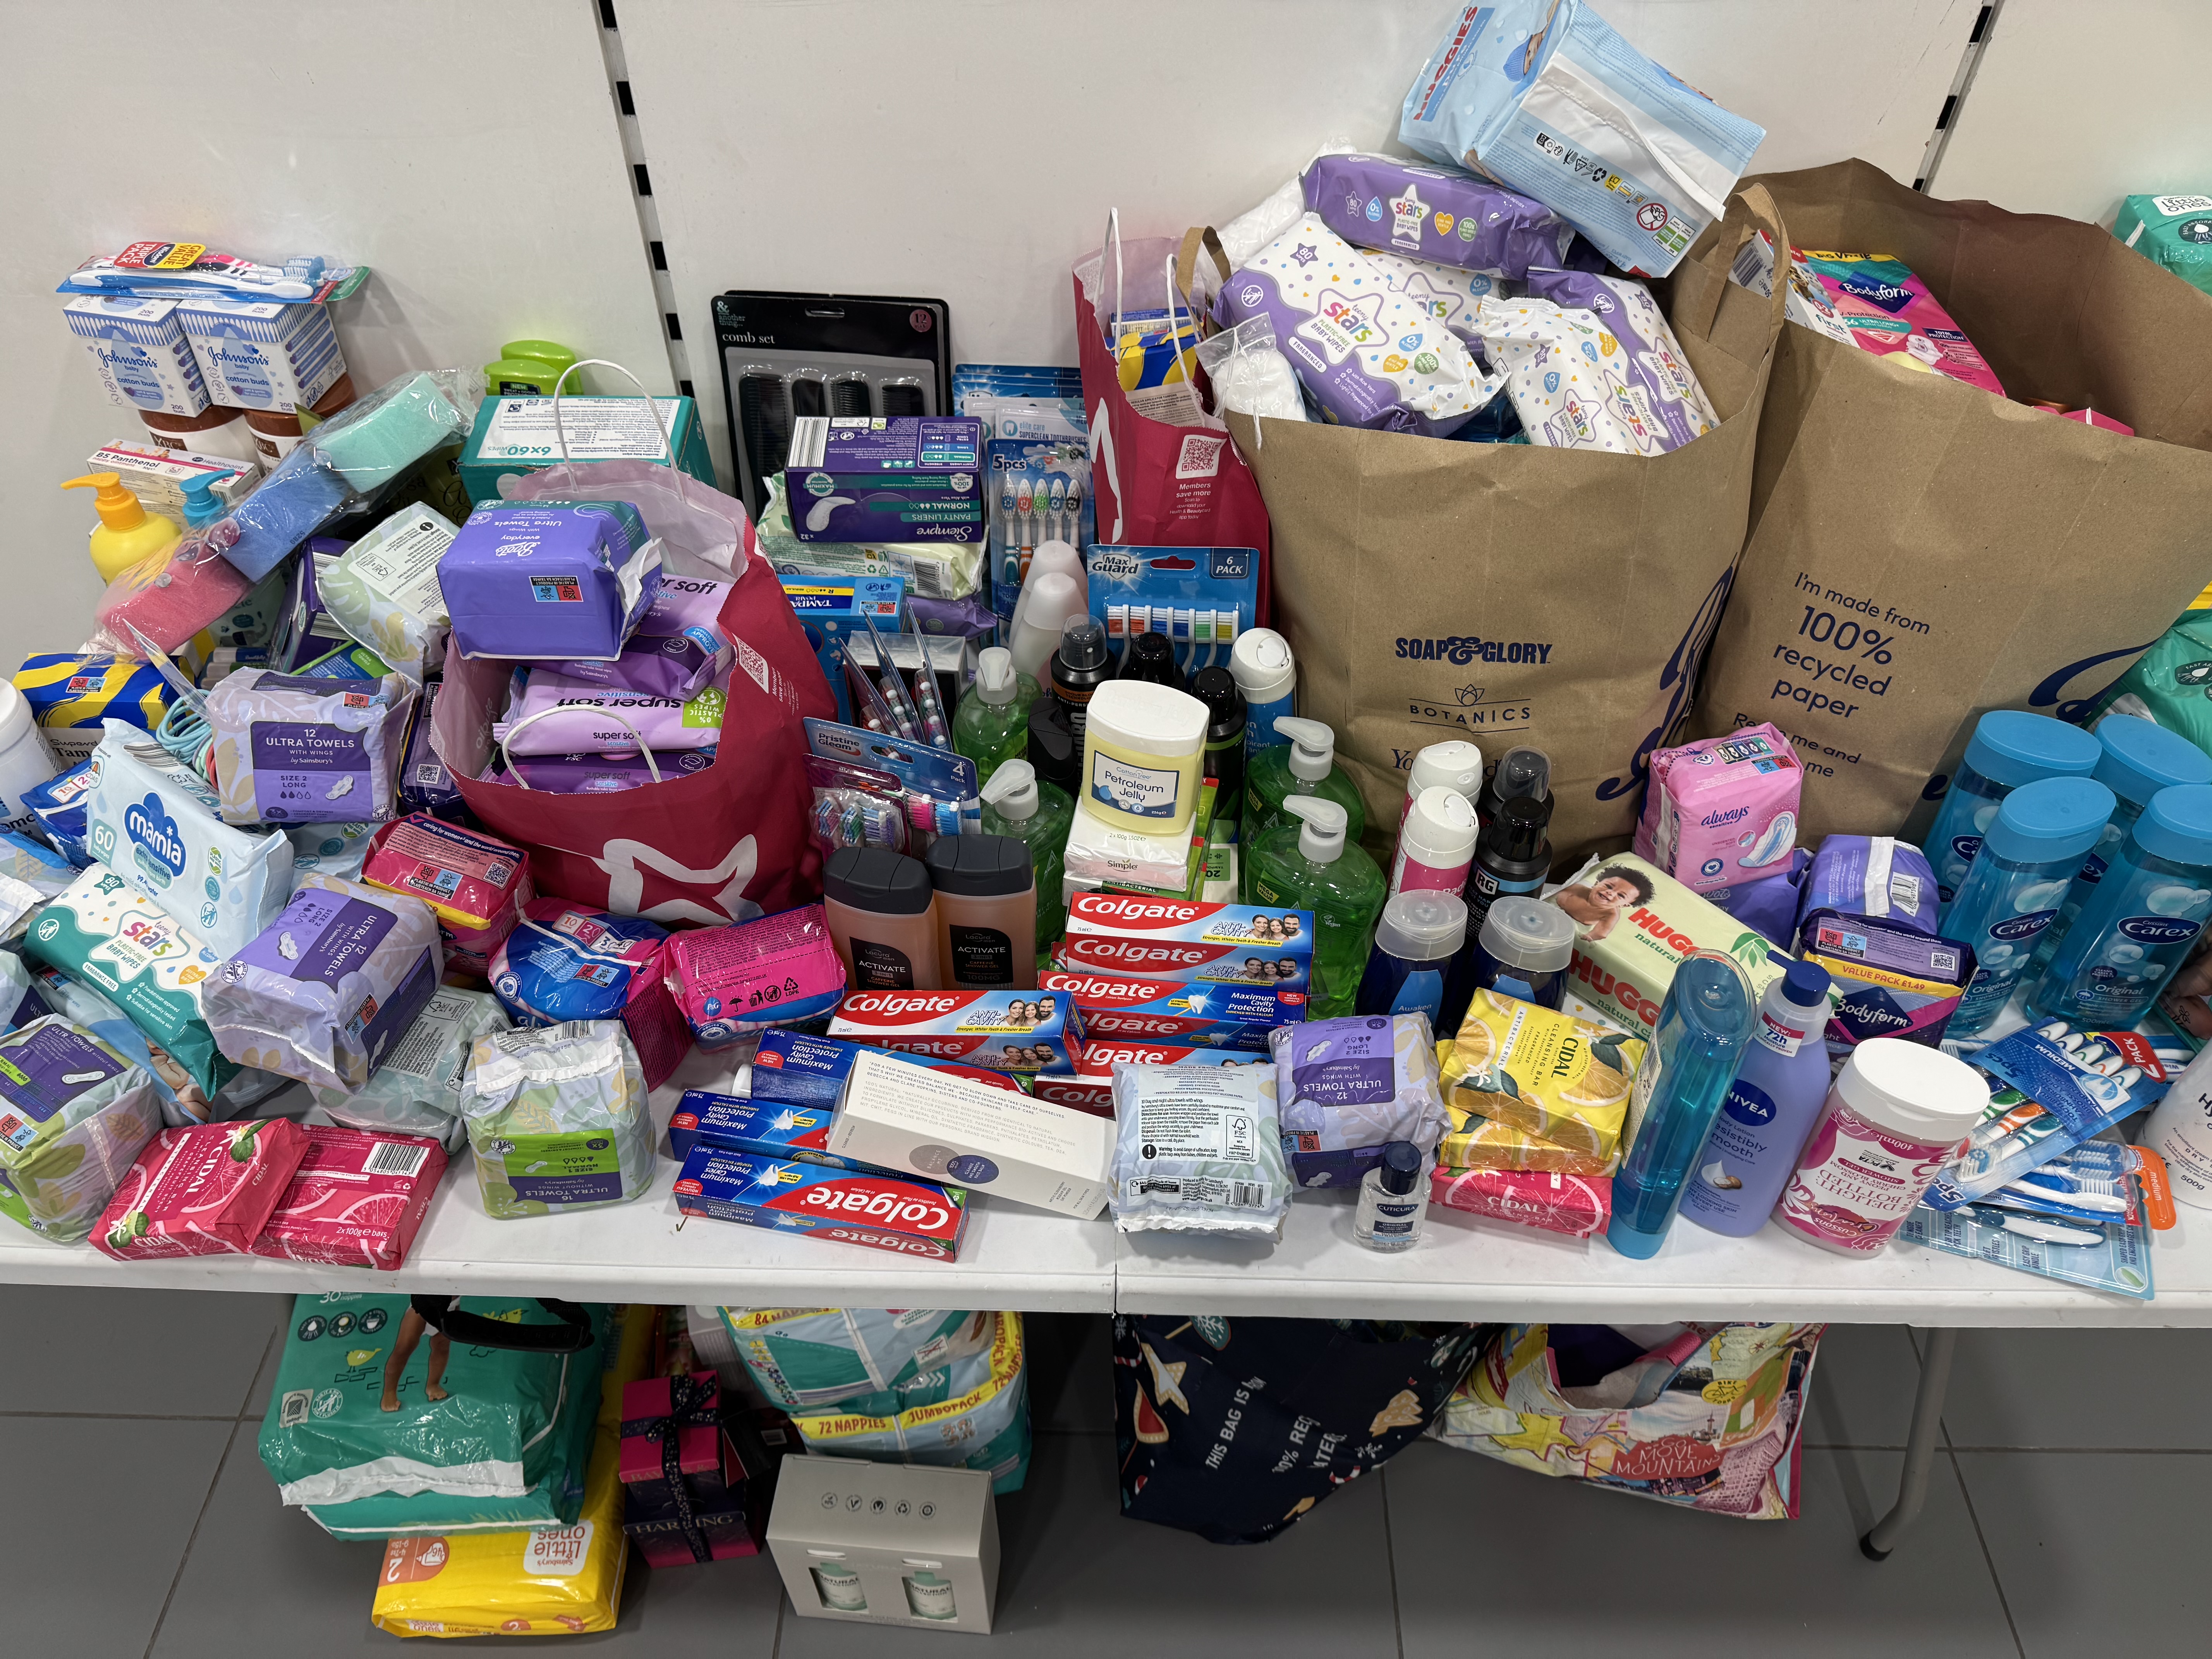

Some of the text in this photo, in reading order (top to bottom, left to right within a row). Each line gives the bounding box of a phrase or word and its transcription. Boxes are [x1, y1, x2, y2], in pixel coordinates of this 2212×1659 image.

[1413, 6, 1478, 120] HUGGIES
[1348, 199, 1357, 208] 80
[1396, 201, 1422, 219] stars
[2161, 198, 2205, 208] Little
[2168, 202, 2212, 212] ones
[117, 244, 142, 263] PACK
[129, 244, 153, 264] TRIPLE
[164, 245, 187, 265] VALUE
[175, 245, 201, 266] GREAT
[1842, 282, 1913, 301] Bodyform
[718, 314, 745, 323] another
[1323, 300, 1373, 342] stars
[722, 332, 775, 344] comb set
[1310, 322, 1345, 354] BABY WIPES
[98, 348, 158, 368] Johnson's
[1293, 341, 1322, 369] FRAGRANCED
[117, 377, 160, 388] cotton buds
[111, 454, 160, 468] Panthenol
[203, 458, 243, 470] Healthpoint
[992, 456, 1025, 471] 5pcs
[917, 525, 972, 541] Siempre
[496, 542, 541, 556] Boots
[1092, 563, 1139, 574] Guard
[1105, 557, 1128, 566] Max
[1216, 565, 1242, 575] PACK
[1795, 572, 1930, 634] I'm made from
[1798, 606, 1894, 665] 100%
[1774, 644, 1891, 696] recycled
[556, 698, 682, 708] super soft
[1771, 679, 1859, 718] paper
[1410, 705, 1530, 724] BOTANICS
[266, 738, 354, 748] ULTRA TOWELS
[304, 730, 315, 738] 12
[593, 730, 641, 740] super sot
[819, 733, 860, 747] Pristine
[51, 739, 98, 748] Superd
[818, 738, 851, 750] Gleam
[1791, 733, 1861, 764] me and
[952, 764, 964, 776] 4
[1805, 761, 1834, 778] me
[1105, 771, 1164, 793] Petroleum
[1120, 788, 1146, 802] Jelly
[1701, 805, 1749, 827] always
[95, 825, 114, 851] 60
[129, 811, 183, 868] mamia
[1107, 860, 1138, 870] Simple
[1259, 883, 1273, 897] MEGA
[1478, 874, 1496, 892] RG
[1259, 888, 1273, 902] VALUE
[1077, 897, 1195, 921] Colgate
[1210, 926, 1251, 937] CAVITY
[1216, 921, 1245, 930] ANTI-
[2125, 922, 2195, 937] Carex
[124, 922, 173, 956] stars
[1634, 932, 1681, 964] natural
[115, 939, 147, 963] PLASTIC-FREE
[85, 964, 117, 990] FRAGRANCE FREE
[1842, 965, 1926, 991] VALUE PACK £1.49
[1231, 992, 1276, 1001] Maximum
[1569, 950, 1661, 1027] HUGG
[2095, 984, 2144, 995] Original
[843, 994, 954, 1015] Colgate
[1228, 1003, 1274, 1013] Protection
[1250, 1000, 1273, 1008] Cavity
[1398, 1003, 1432, 1013] Awaken
[1833, 999, 1908, 1027] Bodyform
[1499, 1010, 1523, 1066] ANTIBACTERIAL
[1763, 1036, 1785, 1048] Moisture
[1766, 1028, 1788, 1044] 72h
[1532, 1024, 1559, 1086] CLEANSING BAR
[1551, 1037, 1578, 1078] CIDAL
[2035, 1044, 2075, 1071] MEDIUM
[2124, 1039, 2162, 1079] 2 PACK
[1727, 1092, 1768, 1118] NIVEA
[1733, 1125, 1755, 1138] Lotion
[137, 1135, 189, 1211] ANTIBACTERIAL
[182, 1146, 223, 1198] CIDAL
[704, 1167, 727, 1176] Caries
[708, 1161, 752, 1174] Protection
[701, 1173, 744, 1186] Maximum
[2151, 1172, 2161, 1201] medium
[2180, 1174, 2205, 1191] 500g
[807, 1186, 950, 1231] Colgate
[909, 1393, 982, 1423] JUMBOPACK
[819, 1418, 885, 1434] 72 NAPPIES
[1205, 1389, 1250, 1470] THIS BAG IS
[1640, 1447, 1697, 1462] MOVE
[1617, 1454, 1720, 1475] MOUNTAINS
[538, 1527, 586, 1540] ones
[634, 1515, 733, 1534] HARING
[534, 1541, 581, 1559] Little
[387, 1558, 401, 1581] 2
[537, 1558, 573, 1566] Sainsbury's
